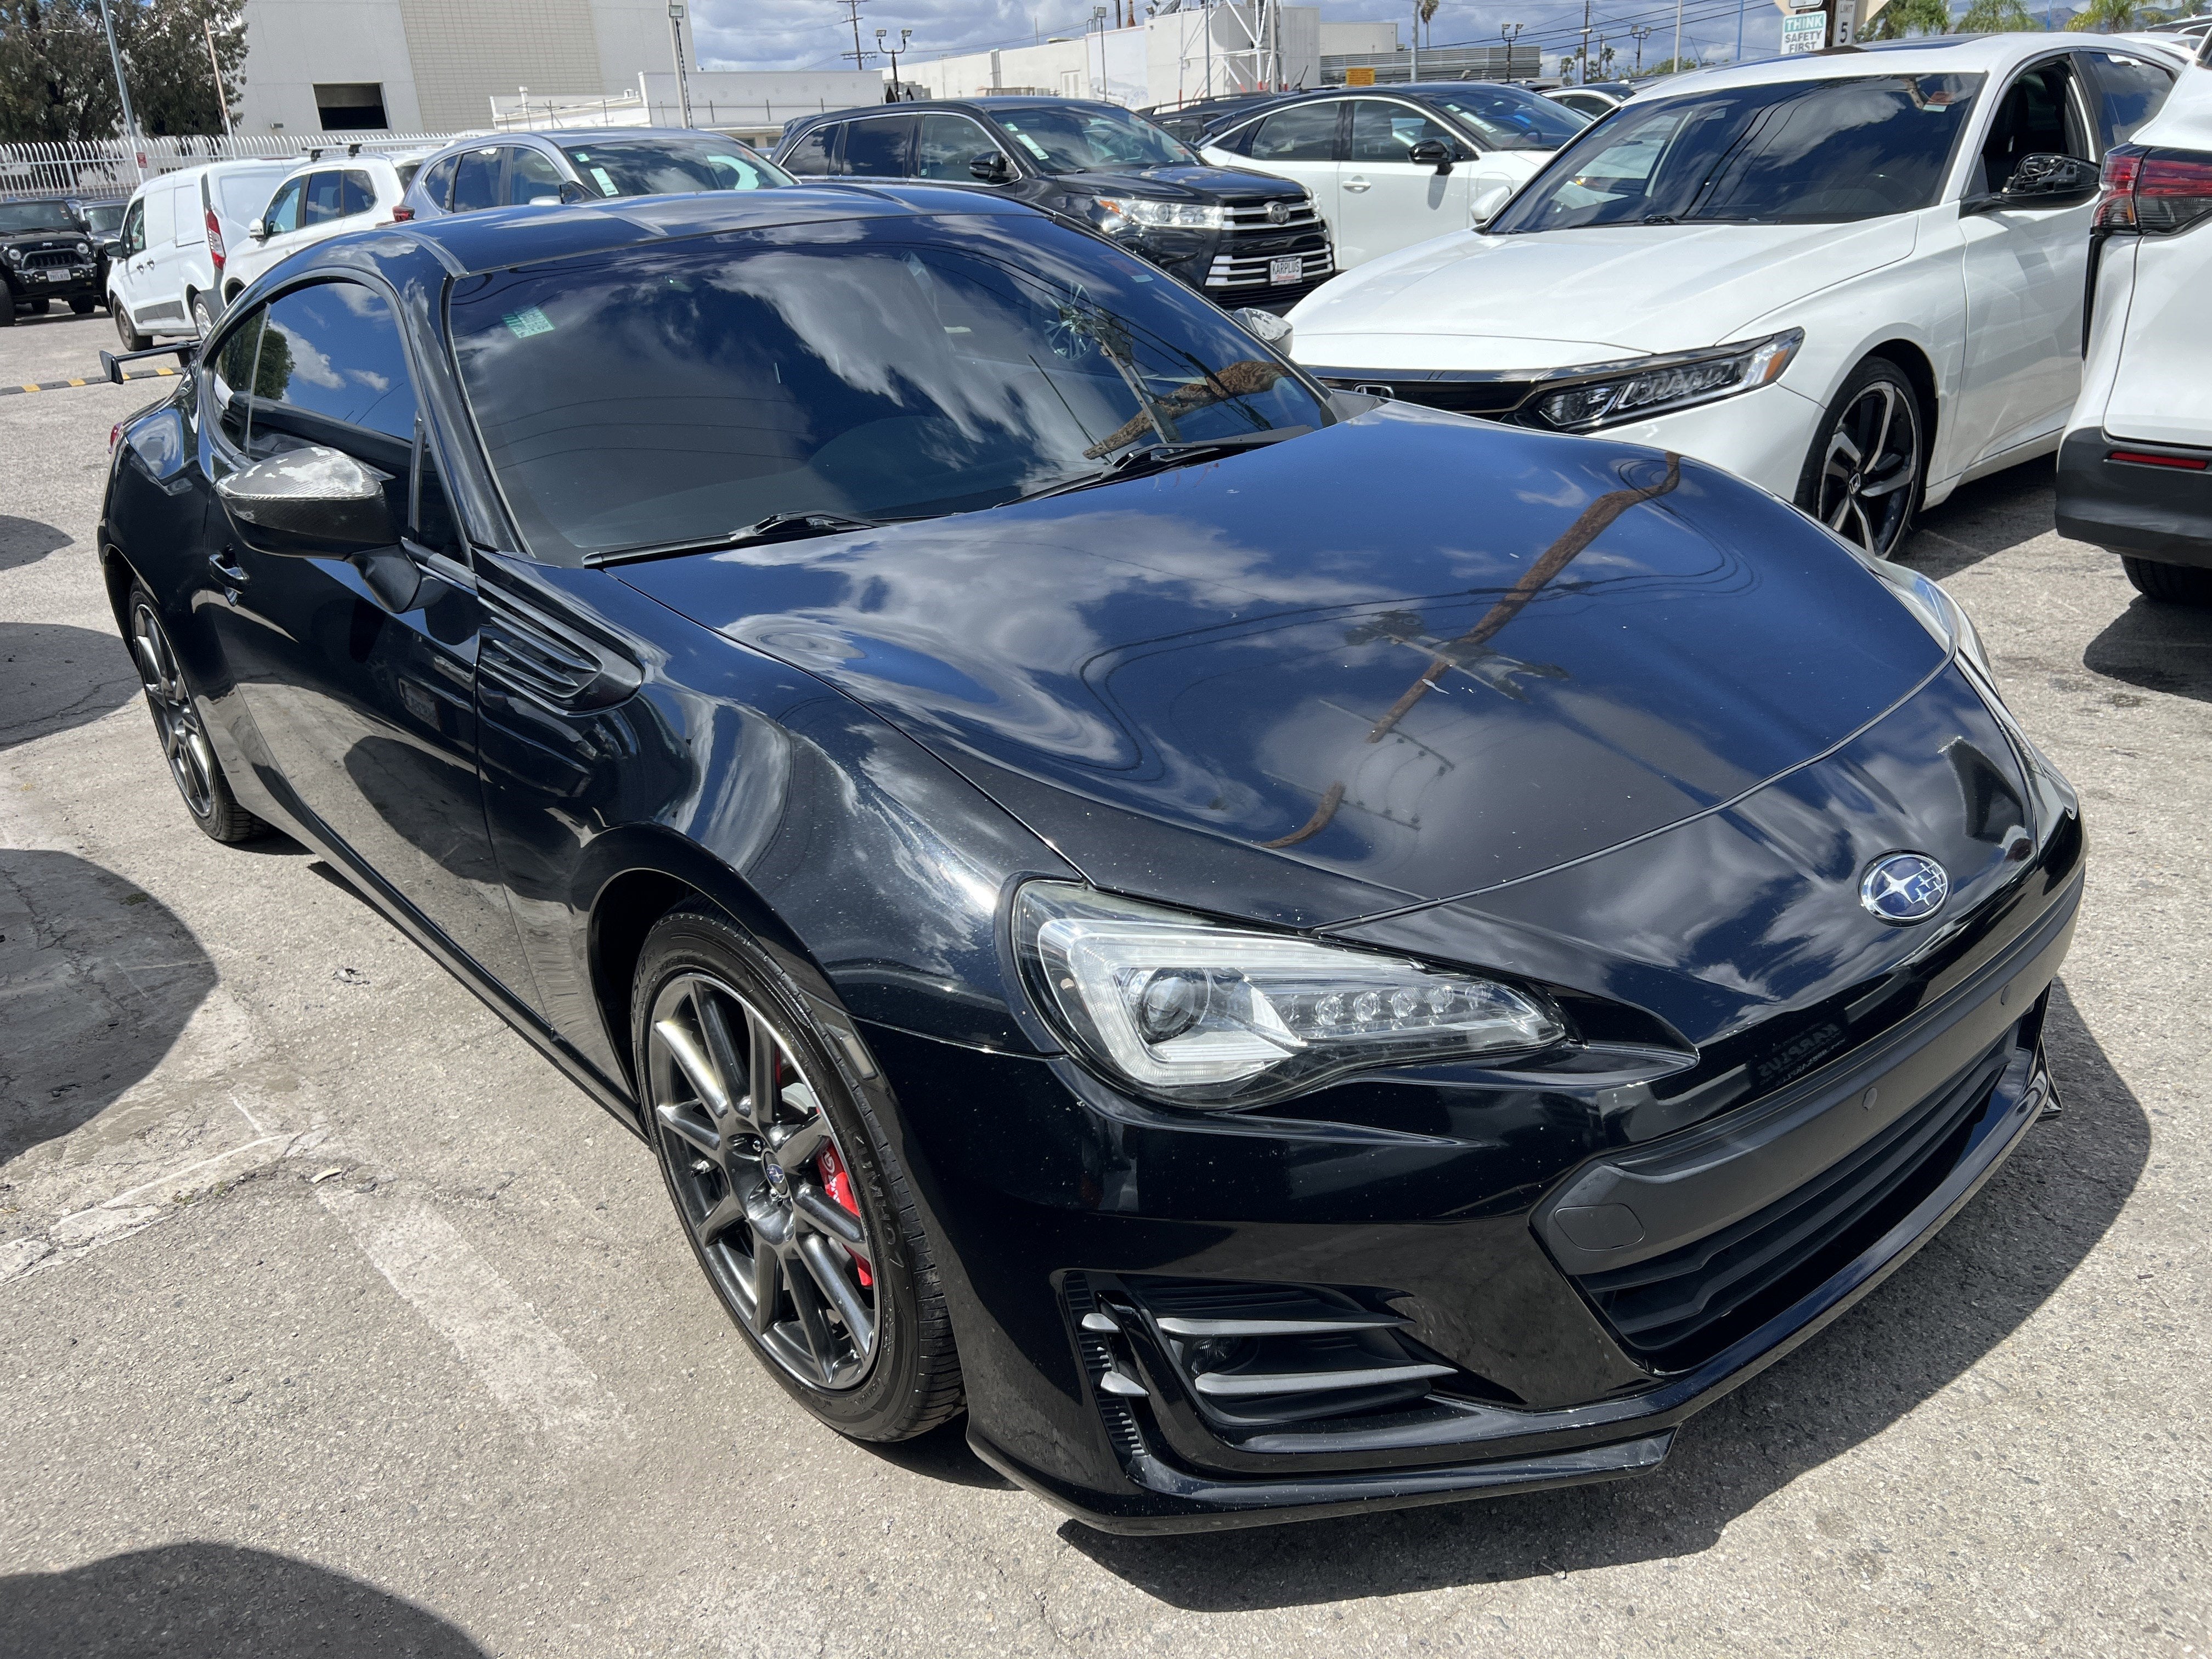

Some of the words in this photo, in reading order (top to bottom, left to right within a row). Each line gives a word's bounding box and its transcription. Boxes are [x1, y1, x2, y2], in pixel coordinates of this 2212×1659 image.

[1840, 4, 1853, 13] LIMIT
[1786, 15, 1822, 30] THINK
[1785, 31, 1821, 43] SAFETY
[1840, 22, 1848, 43] 5
[1790, 42, 1816, 53] FIRST
[1273, 262, 1299, 274] KARPLUS
[848, 1126, 896, 1245] KUMHO
